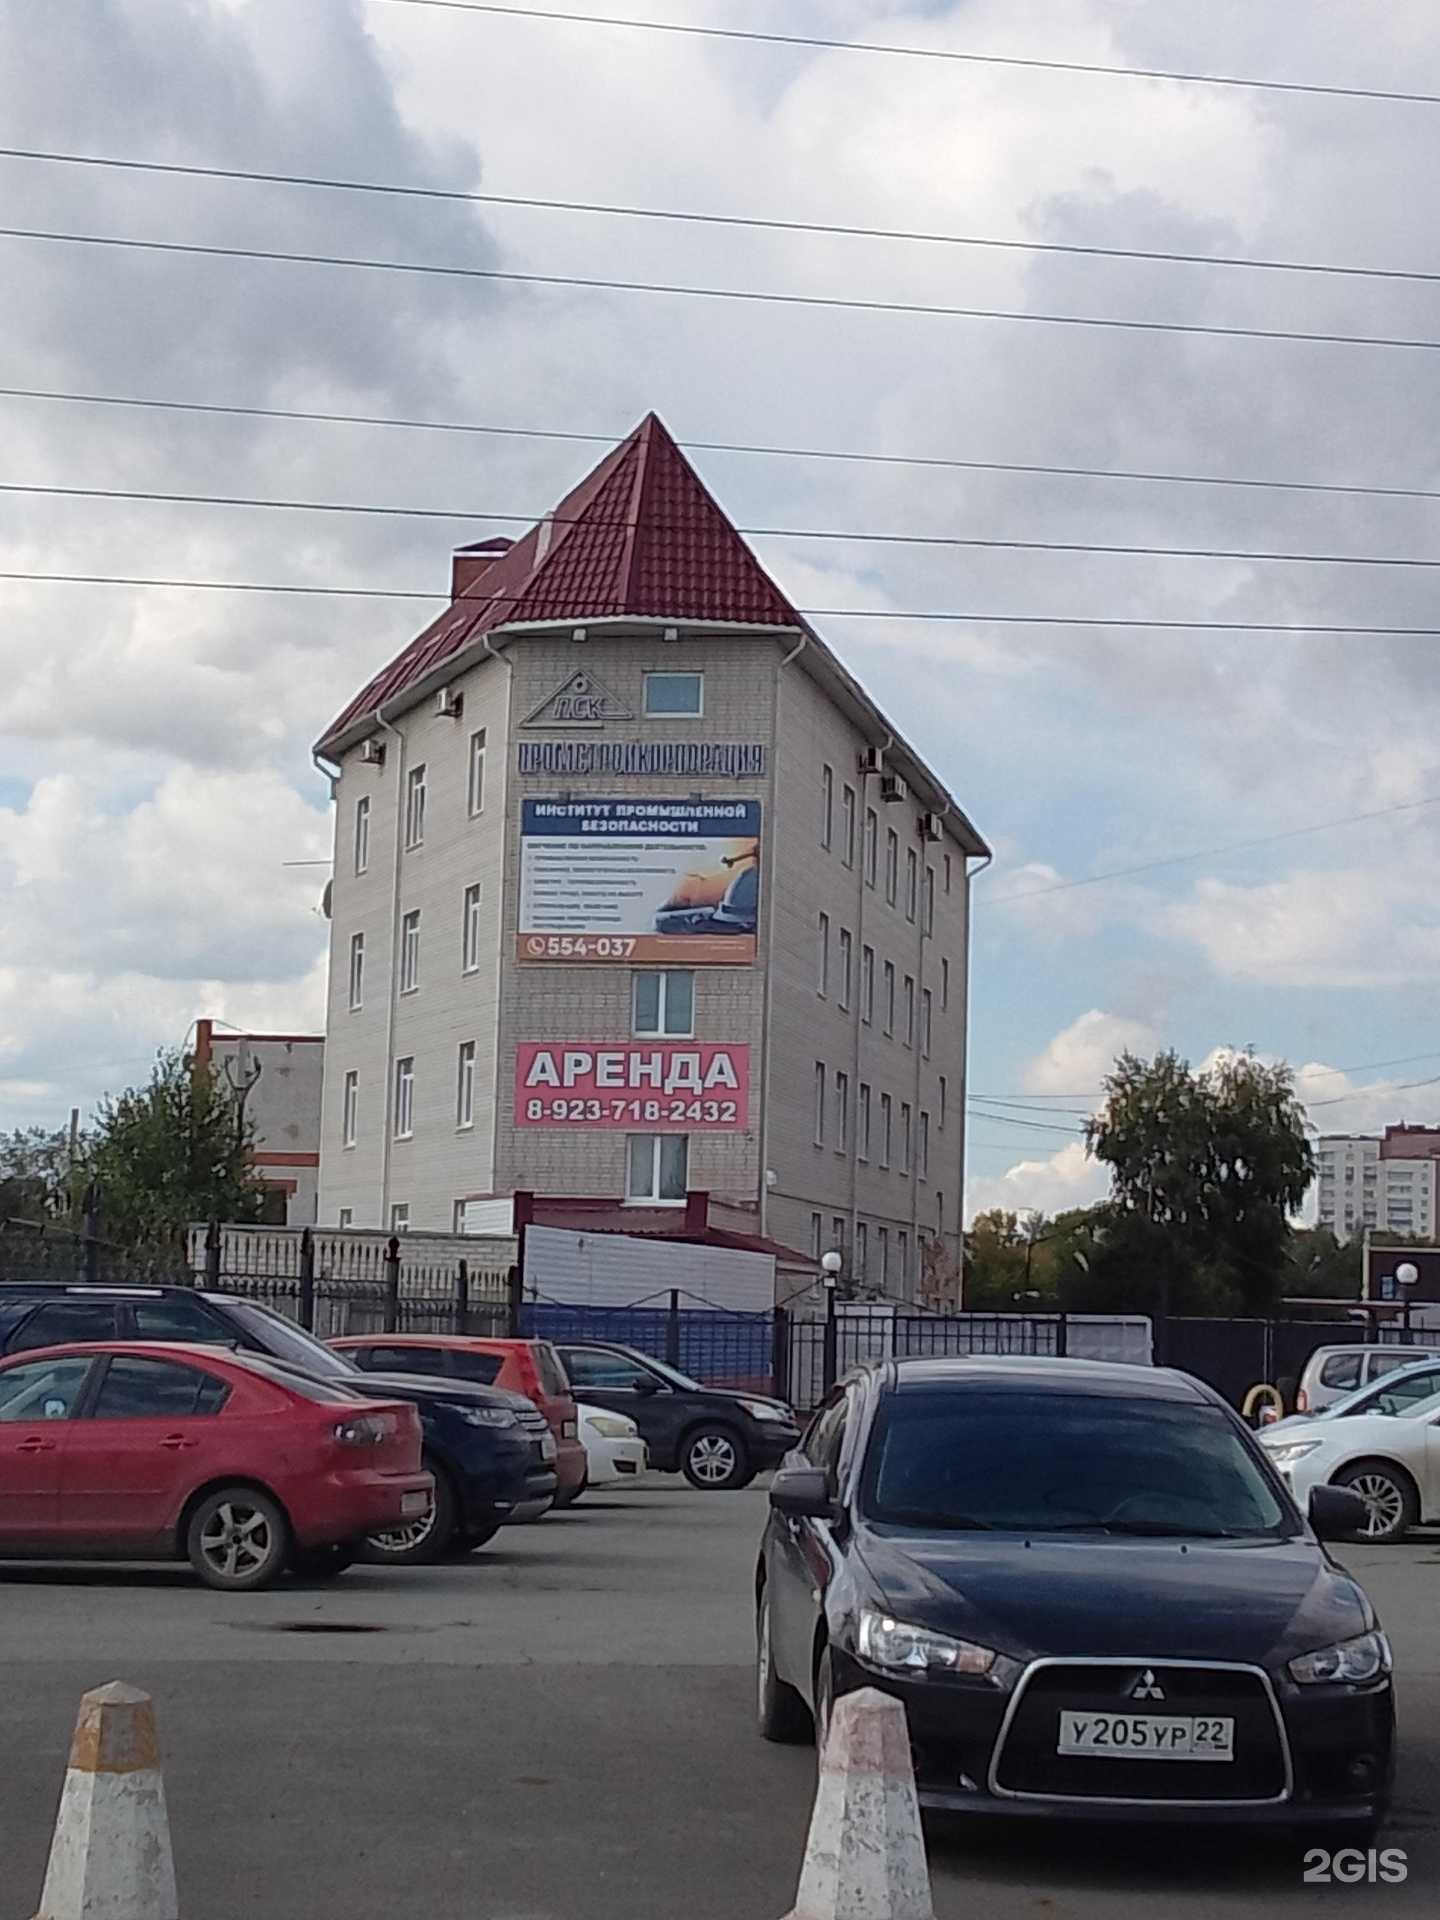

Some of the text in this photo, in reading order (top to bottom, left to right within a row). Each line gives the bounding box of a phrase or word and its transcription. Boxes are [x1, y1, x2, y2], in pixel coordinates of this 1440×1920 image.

[535, 804, 746, 818] ИНСТИТУТ ПРОМЫШЛЕННОЙ
[581, 820, 698, 833] БЕЗОПАСНОСТИ
[547, 938, 636, 957] 554-037
[524, 1051, 739, 1095] АРЕНДА
[526, 1099, 737, 1122] 8-923-718-2432
